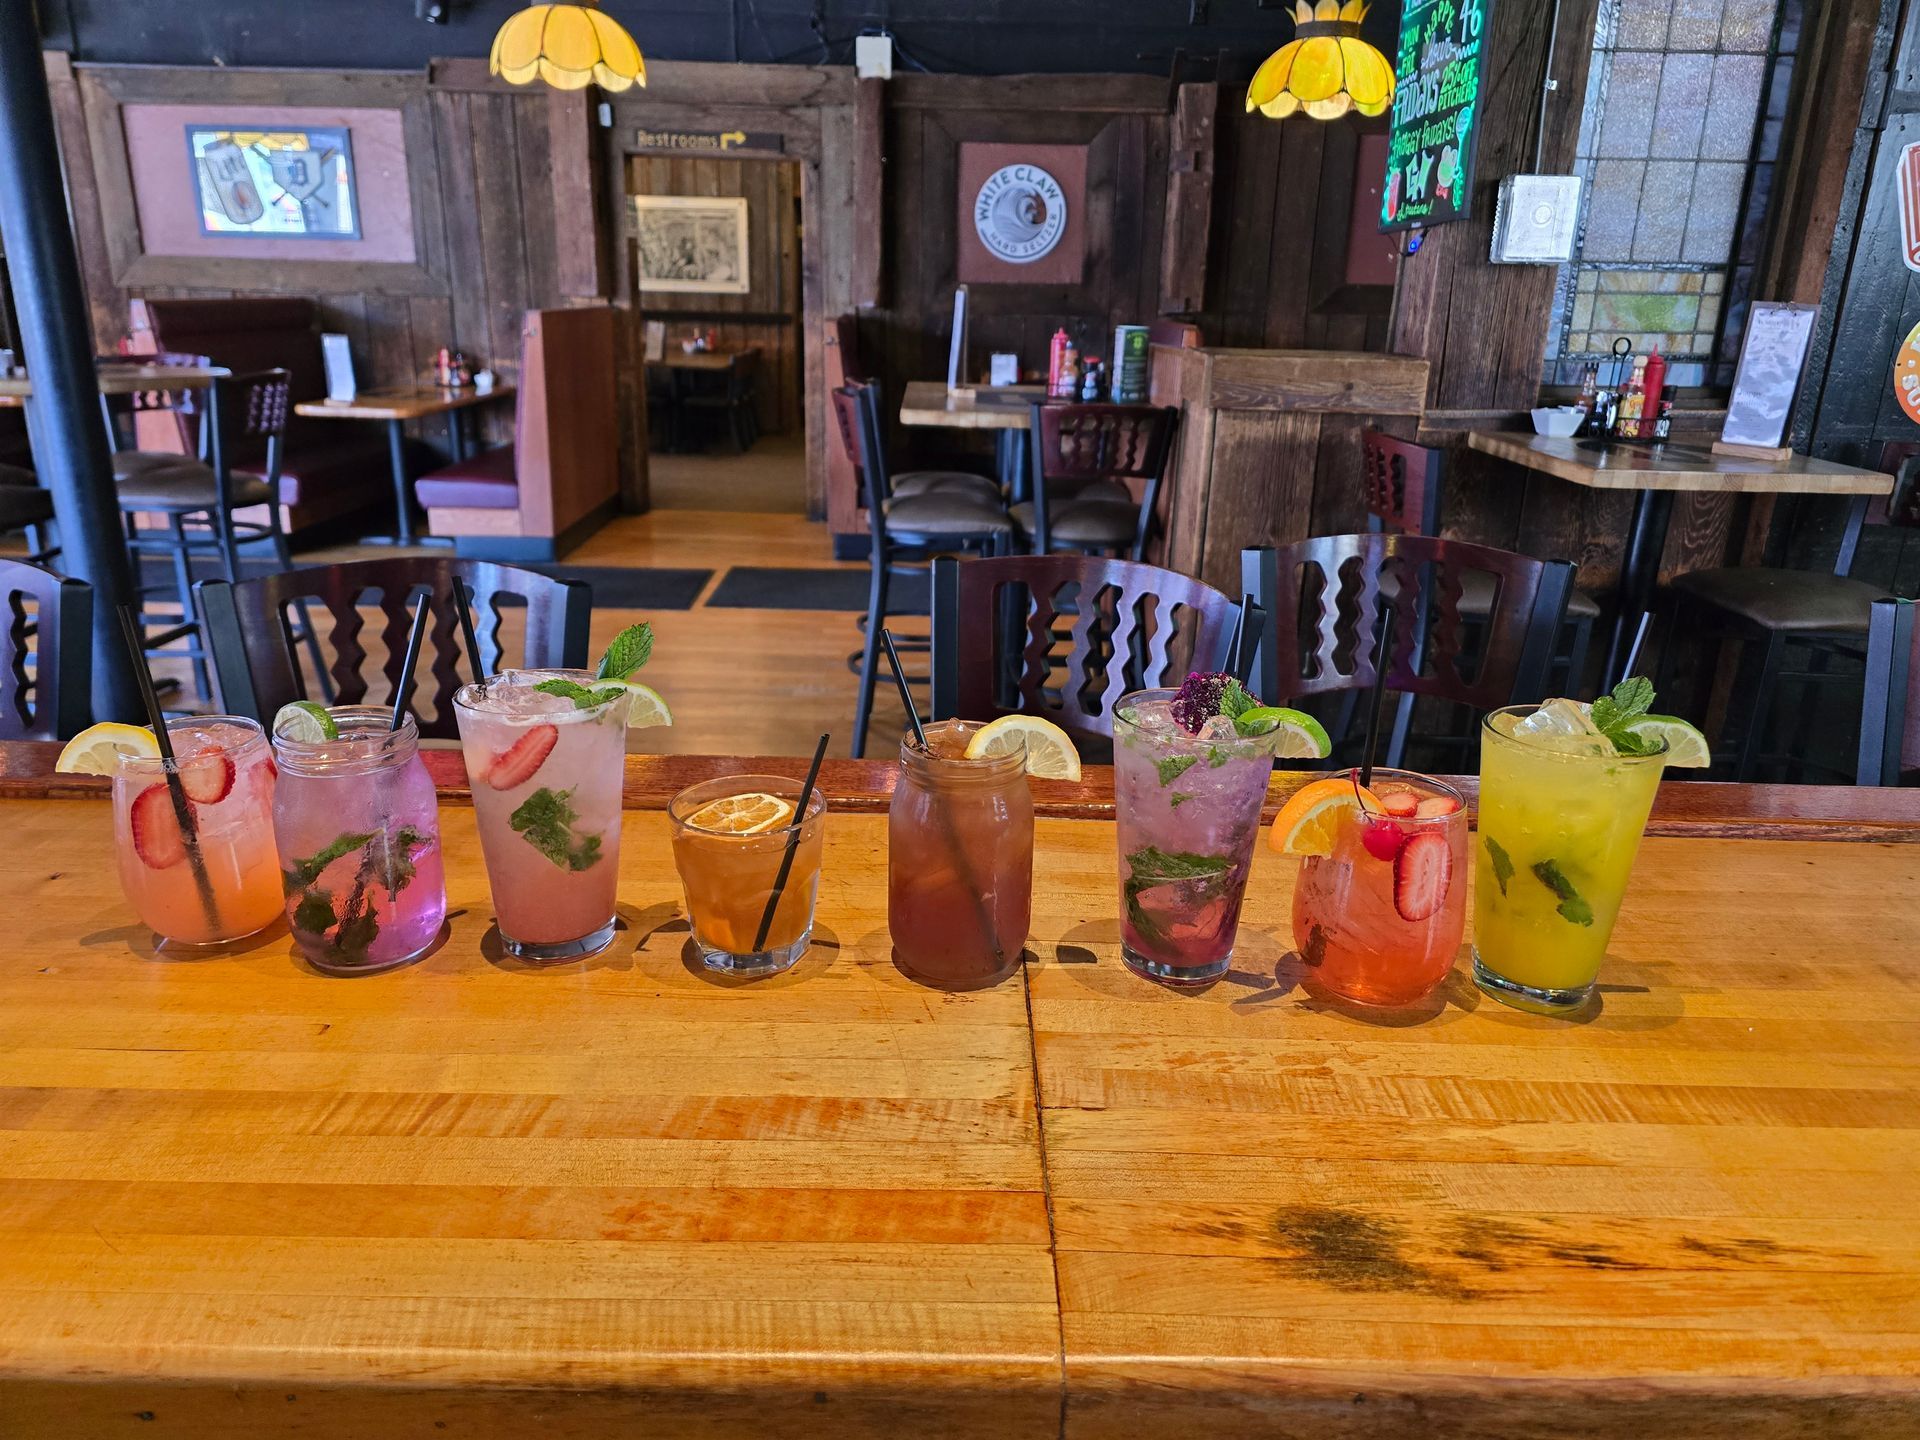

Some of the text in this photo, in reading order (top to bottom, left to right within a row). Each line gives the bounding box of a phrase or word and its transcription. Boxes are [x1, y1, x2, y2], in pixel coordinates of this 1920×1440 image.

[1438, 77, 1478, 112] PITCHERS
[638, 130, 717, 148] Restrooms
[979, 167, 1059, 221] WHITE CLAW
[990, 213, 1057, 253] HARD SELTZER
